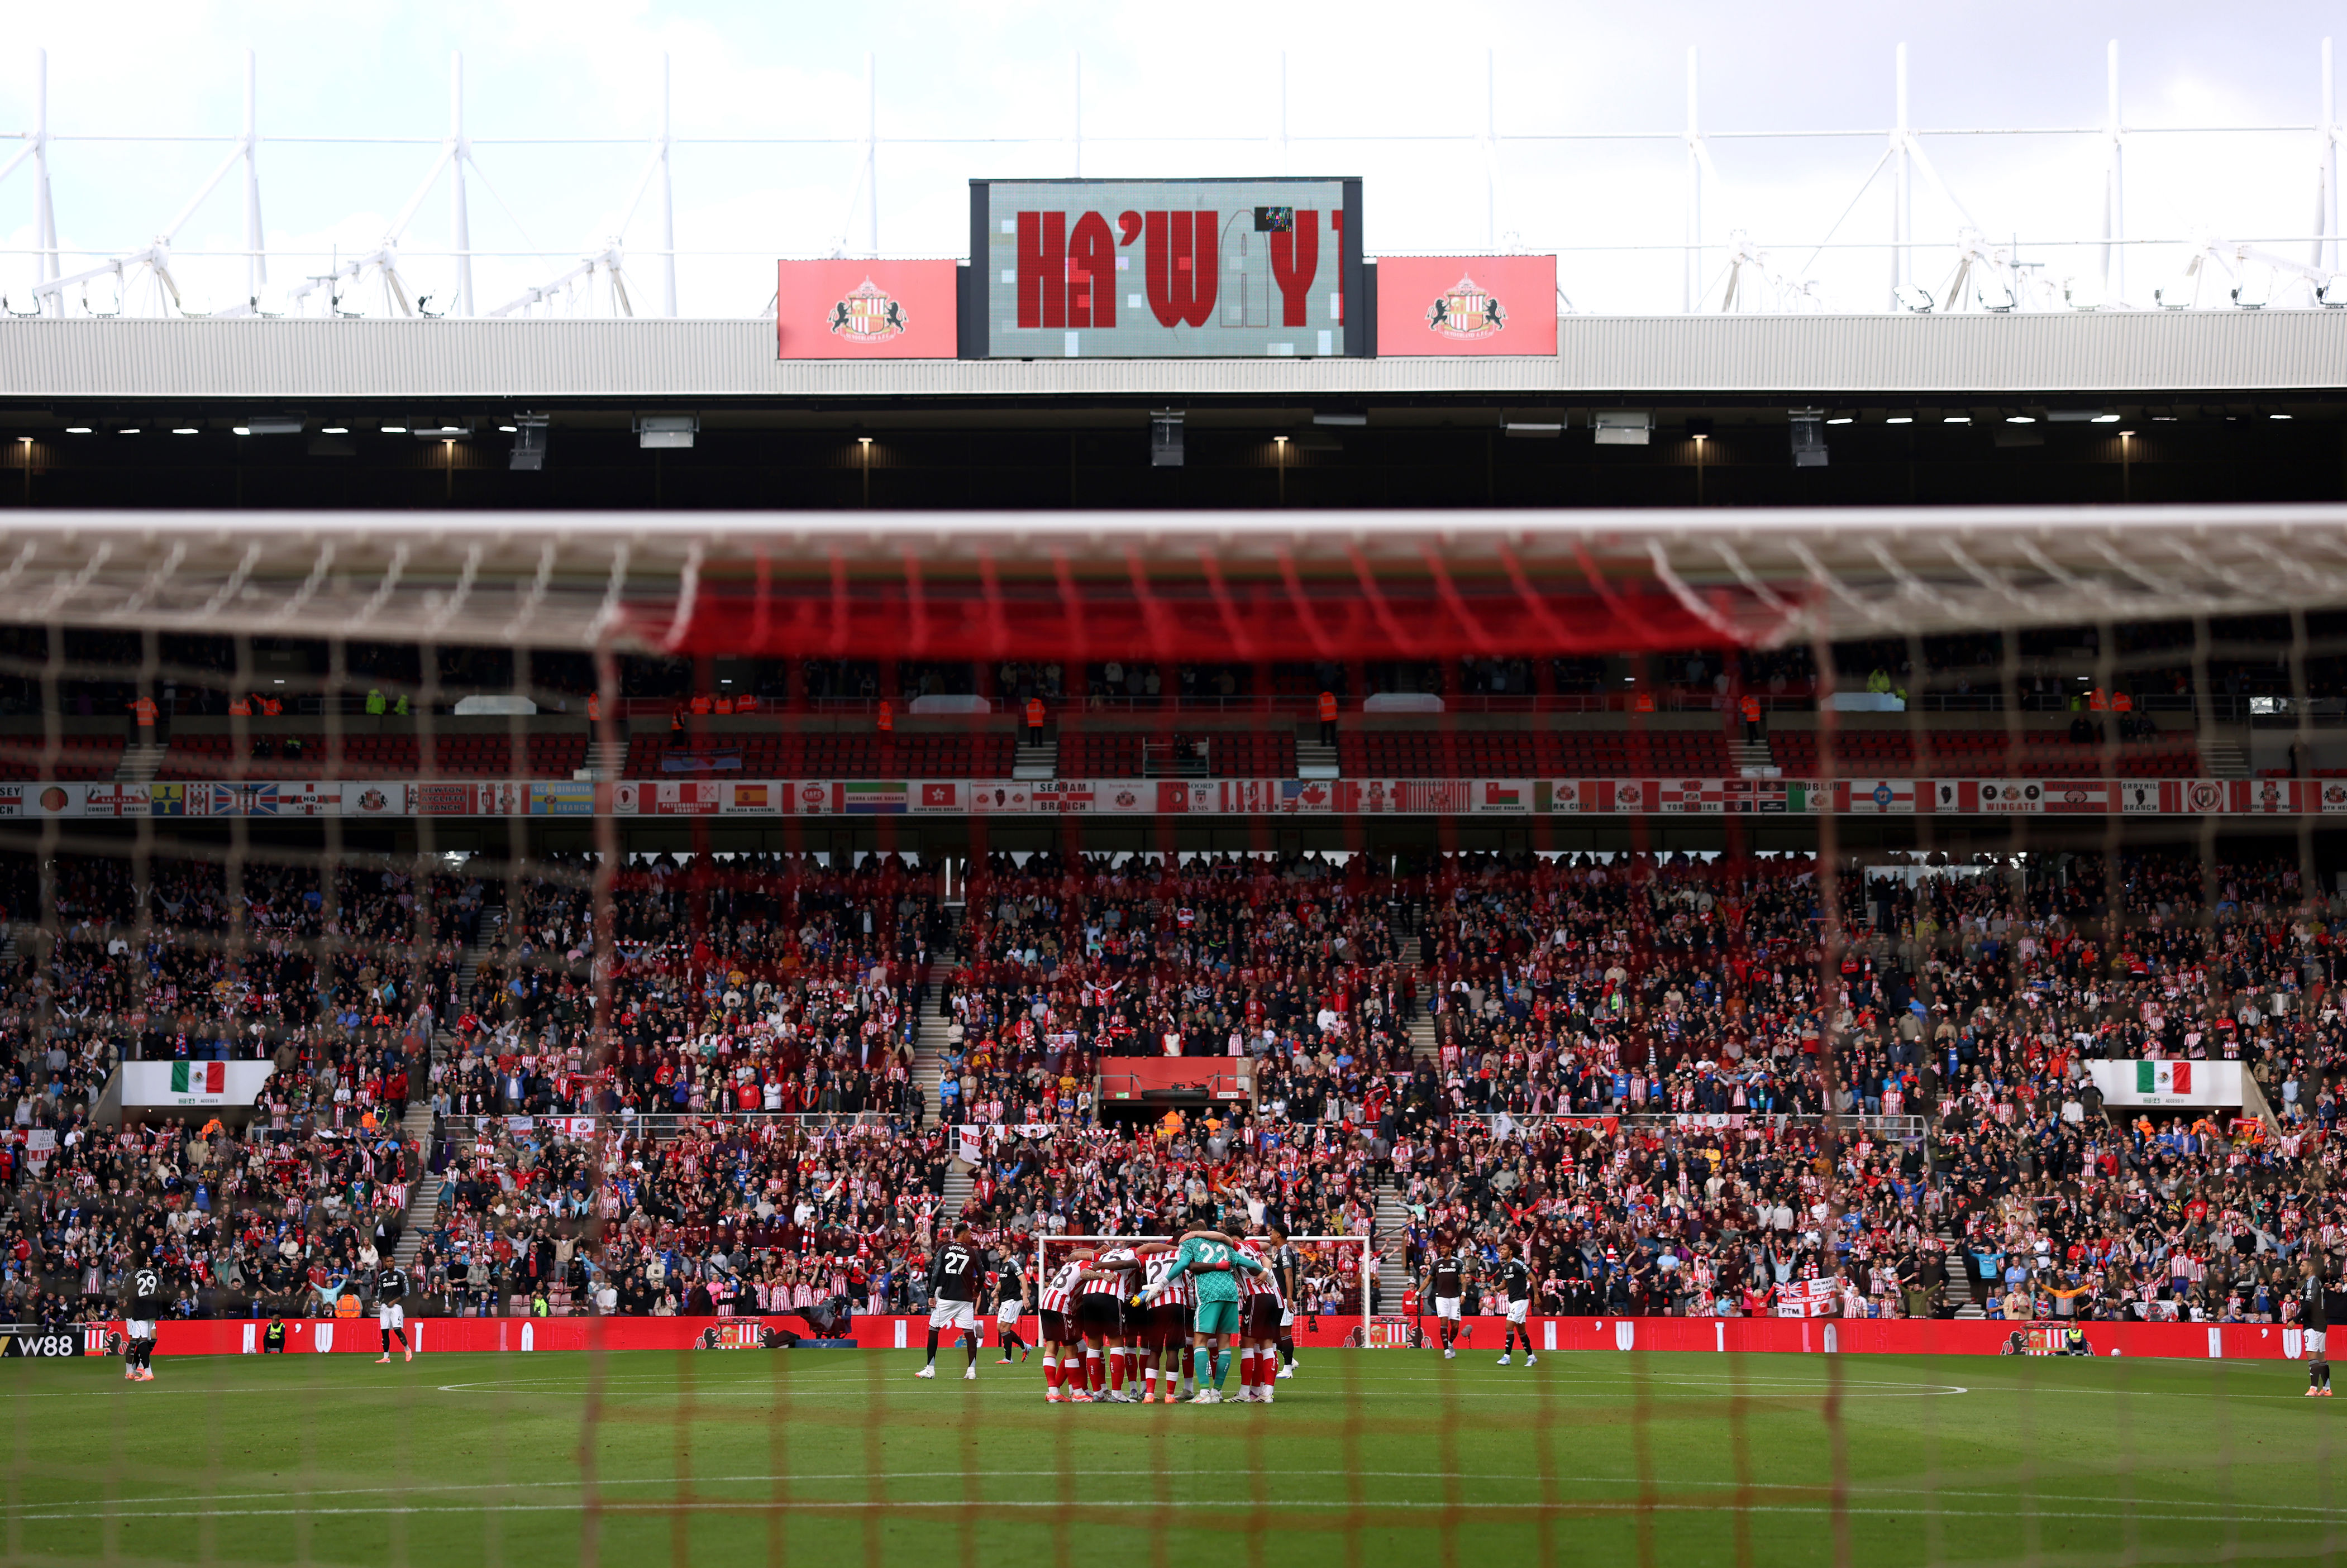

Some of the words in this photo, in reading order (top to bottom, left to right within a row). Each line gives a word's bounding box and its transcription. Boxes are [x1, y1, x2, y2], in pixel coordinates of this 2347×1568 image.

[1017, 210, 1318, 328] HA'WAY
[1040, 783, 1086, 792] SEAHAM
[1795, 783, 1841, 791] DUBLIN
[1041, 802, 1086, 810] BRANCH
[1986, 802, 2036, 811] WINGATE
[948, 1245, 968, 1254] ROGERS
[1199, 1242, 1228, 1264] 22
[944, 1251, 970, 1275] 27
[134, 1269, 154, 1279] GUESSAND
[1148, 1259, 1178, 1284] 27
[136, 1275, 158, 1298] 29
[1781, 1293, 1831, 1304] SUNDERLAND
[17, 1335, 73, 1357] W88
